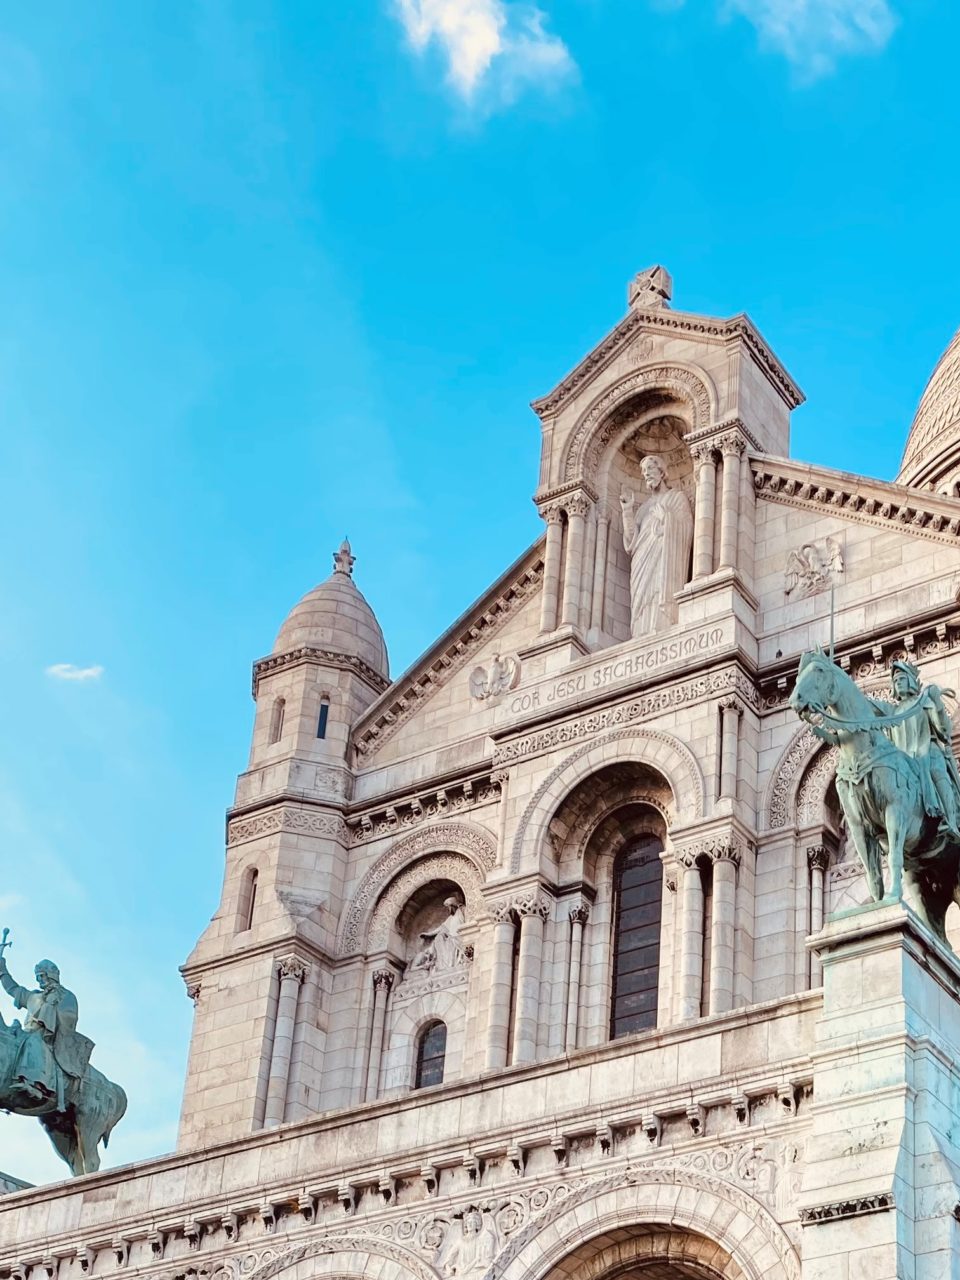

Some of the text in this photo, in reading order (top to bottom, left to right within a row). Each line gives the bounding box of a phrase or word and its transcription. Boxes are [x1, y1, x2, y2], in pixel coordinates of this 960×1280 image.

[511, 628, 724, 714] COR JESU SACRATISSIMUM
